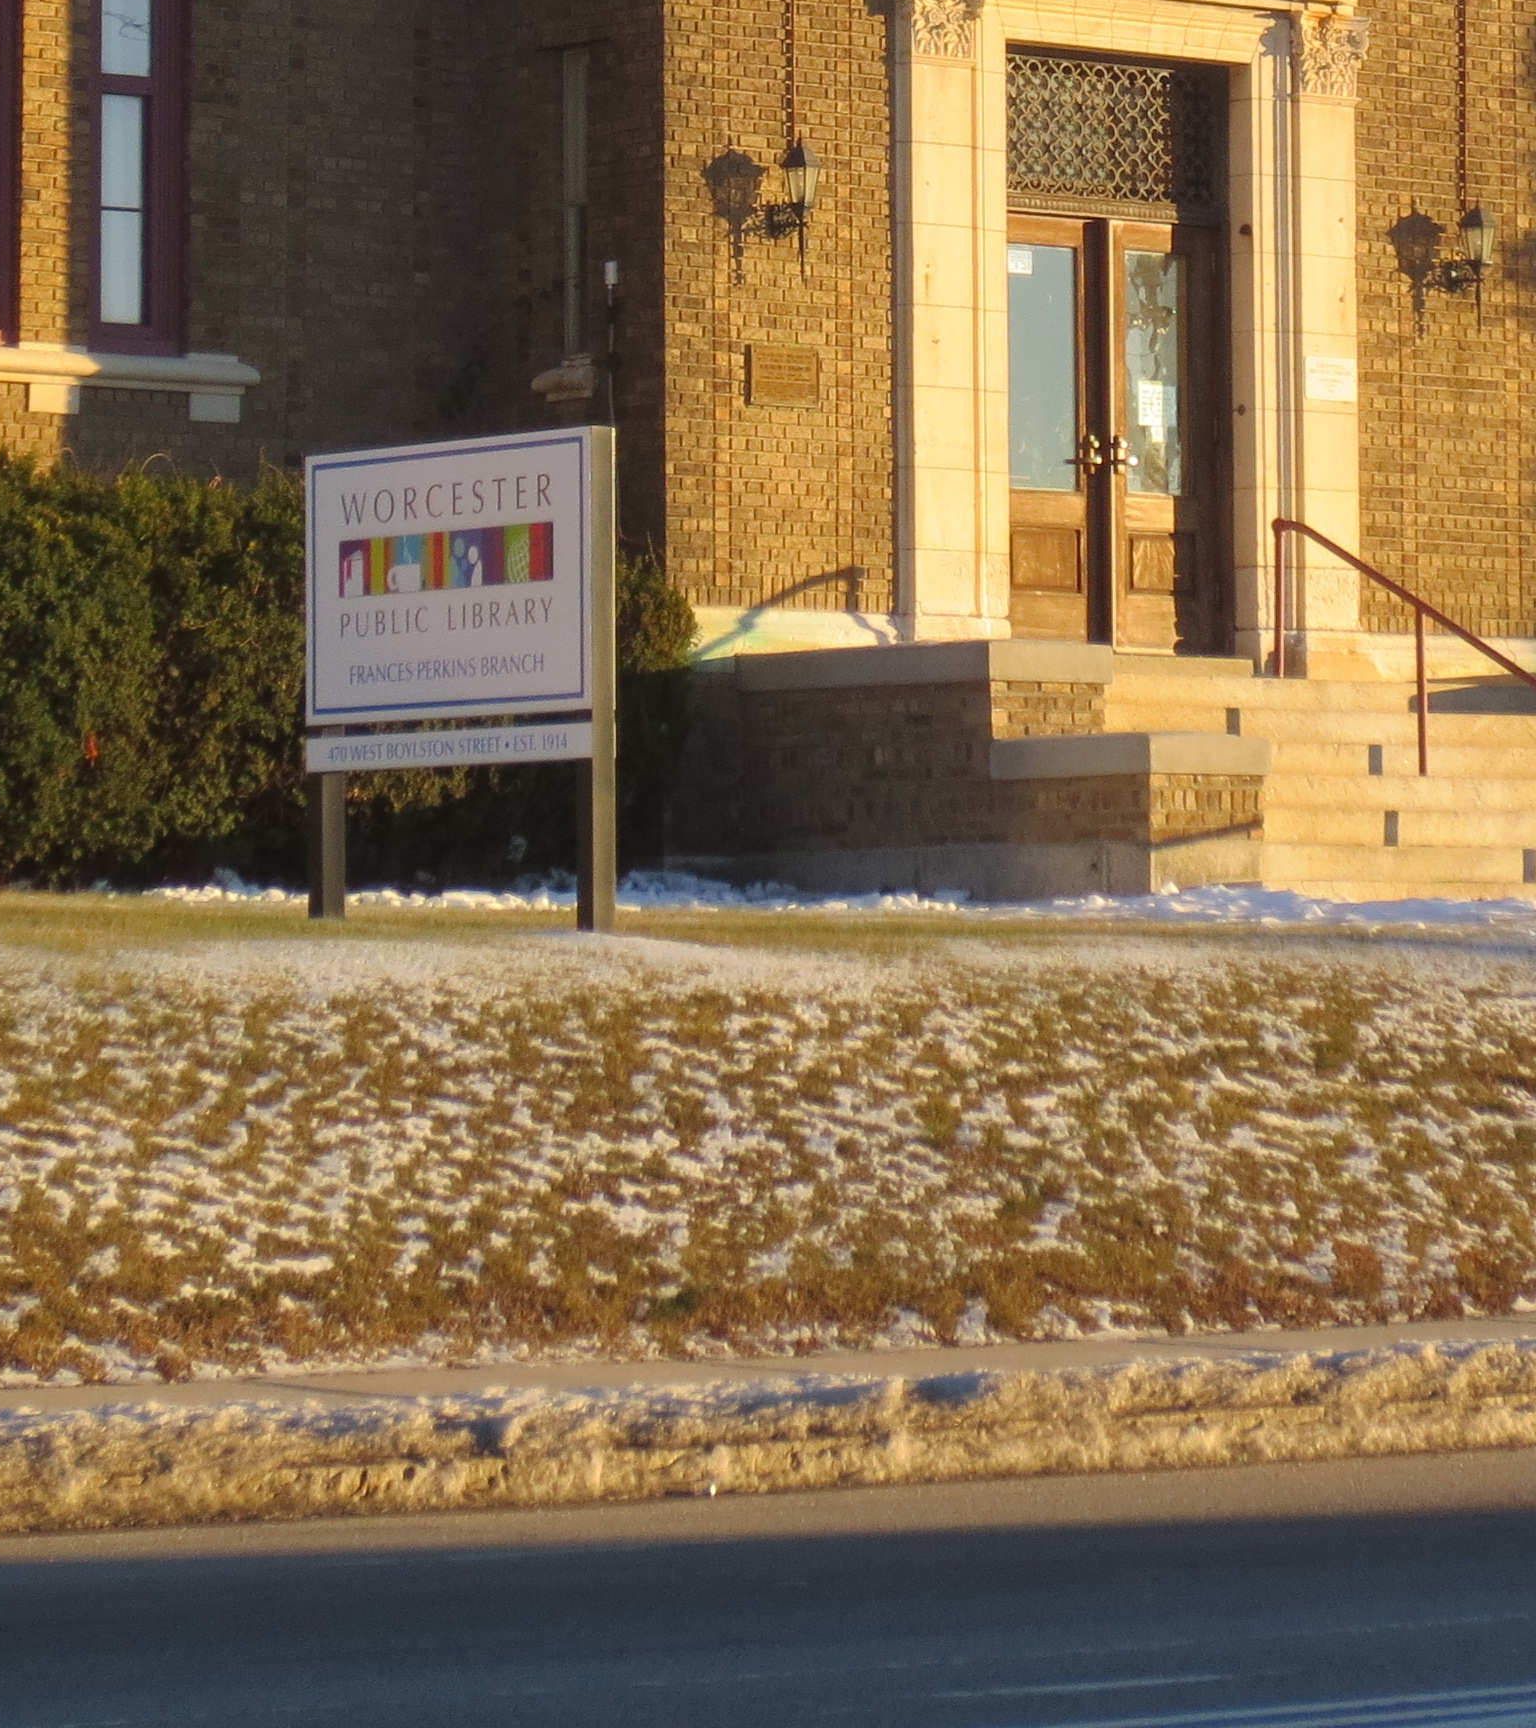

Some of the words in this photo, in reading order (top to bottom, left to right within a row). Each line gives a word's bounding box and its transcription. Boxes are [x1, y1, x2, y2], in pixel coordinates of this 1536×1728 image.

[341, 473, 552, 526] WORCESTER
[340, 605, 429, 638] PUBLIC
[447, 597, 553, 631] LIBRARY
[349, 661, 413, 685] FRANCES
[417, 655, 476, 680] PERKINS
[481, 652, 545, 677] BRANCH
[328, 746, 348, 762] 470
[350, 743, 383, 761] WEST
[386, 738, 454, 760] BOYLSTON
[458, 735, 501, 755] STREET
[513, 734, 538, 752] EST.
